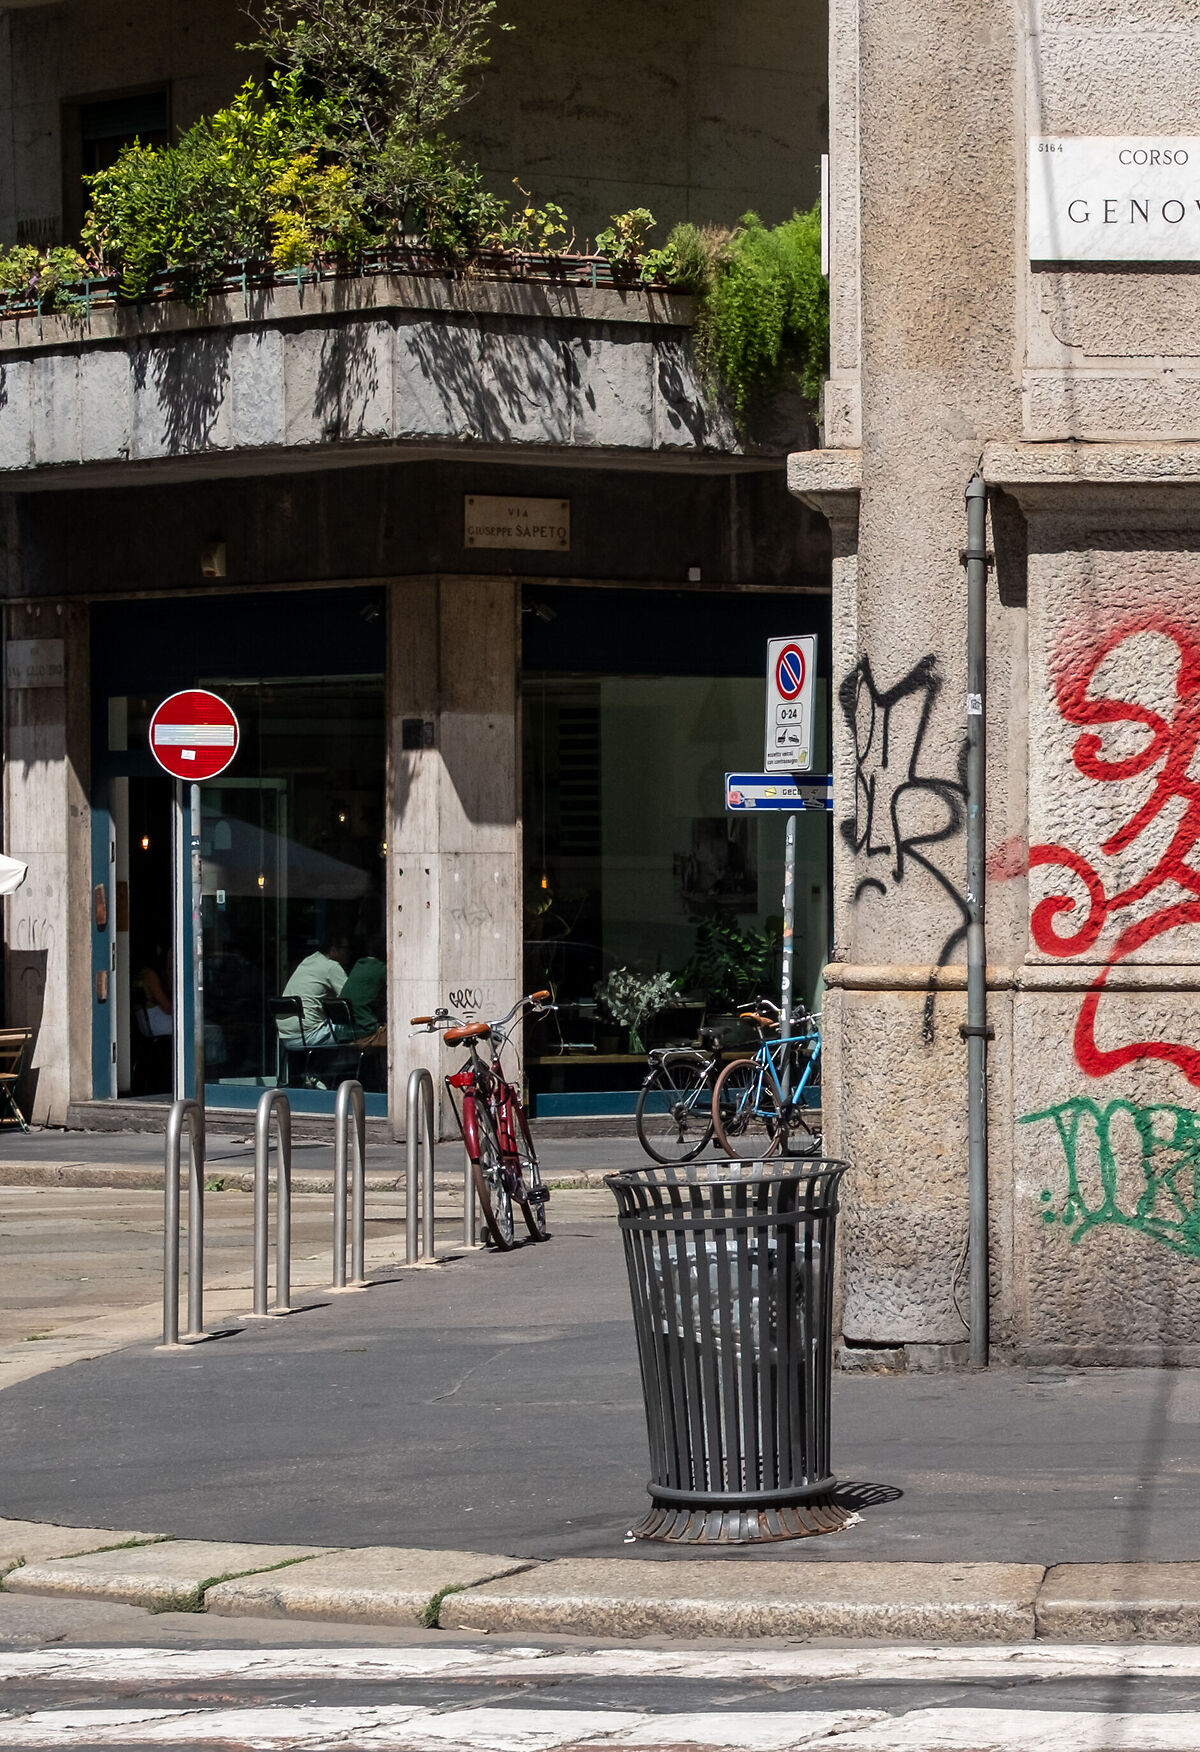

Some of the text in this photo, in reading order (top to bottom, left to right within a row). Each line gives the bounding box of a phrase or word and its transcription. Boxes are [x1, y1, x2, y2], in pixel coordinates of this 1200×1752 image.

[1038, 143, 1064, 153] 5164
[1118, 149, 1189, 165] CORSO
[507, 507, 529, 518] VIA
[467, 525, 567, 539] GIUSEPPE SAPETO
